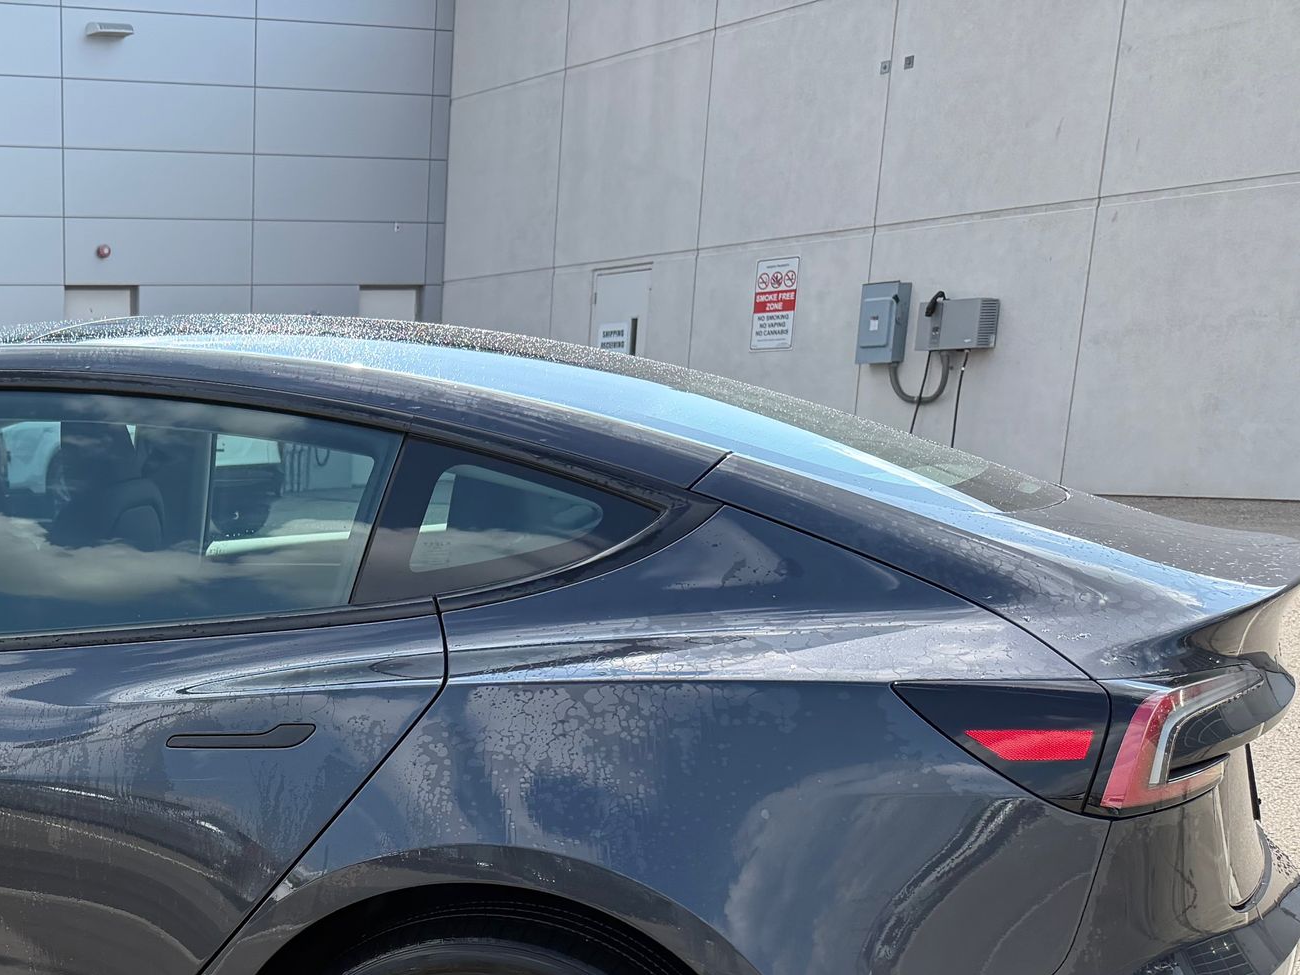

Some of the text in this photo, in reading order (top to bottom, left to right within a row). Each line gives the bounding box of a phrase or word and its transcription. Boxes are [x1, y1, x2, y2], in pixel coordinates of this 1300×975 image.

[756, 291, 795, 302] SMOKE FREE
[765, 302, 783, 310] ZONE
[763, 328, 789, 337] CANNABIS
